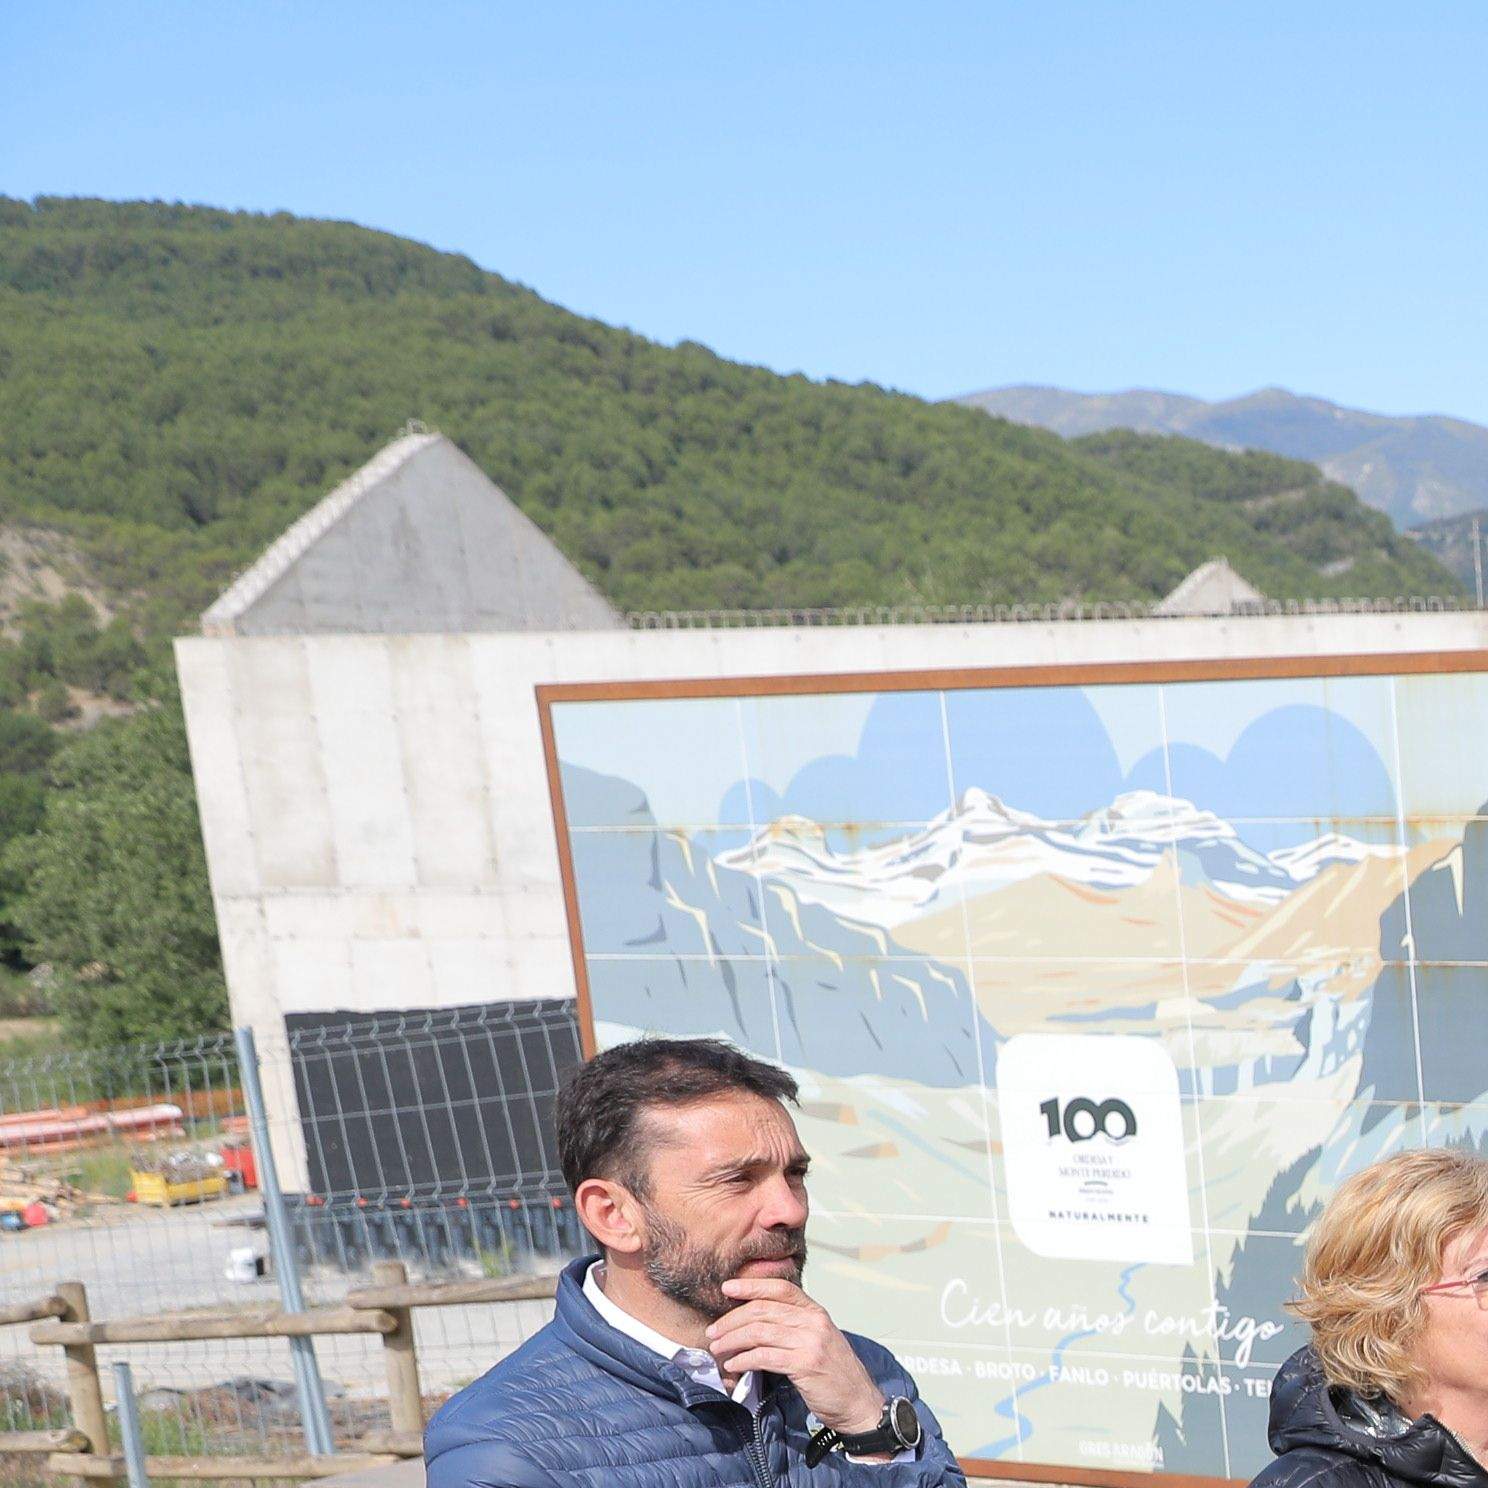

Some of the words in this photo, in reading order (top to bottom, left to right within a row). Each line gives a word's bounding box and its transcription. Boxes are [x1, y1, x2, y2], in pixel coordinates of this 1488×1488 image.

[1040, 1096, 1137, 1144] 100
[1048, 1209, 1149, 1224] NATURALMENTE
[940, 1277, 1038, 1329] Cien
[1043, 1302, 1136, 1335] años
[1143, 1298, 1285, 1368] contigo
[975, 1362, 1037, 1381] BROTO
[1049, 1365, 1109, 1386] FANLO
[1123, 1364, 1232, 1396] PUÉRTOLAS
